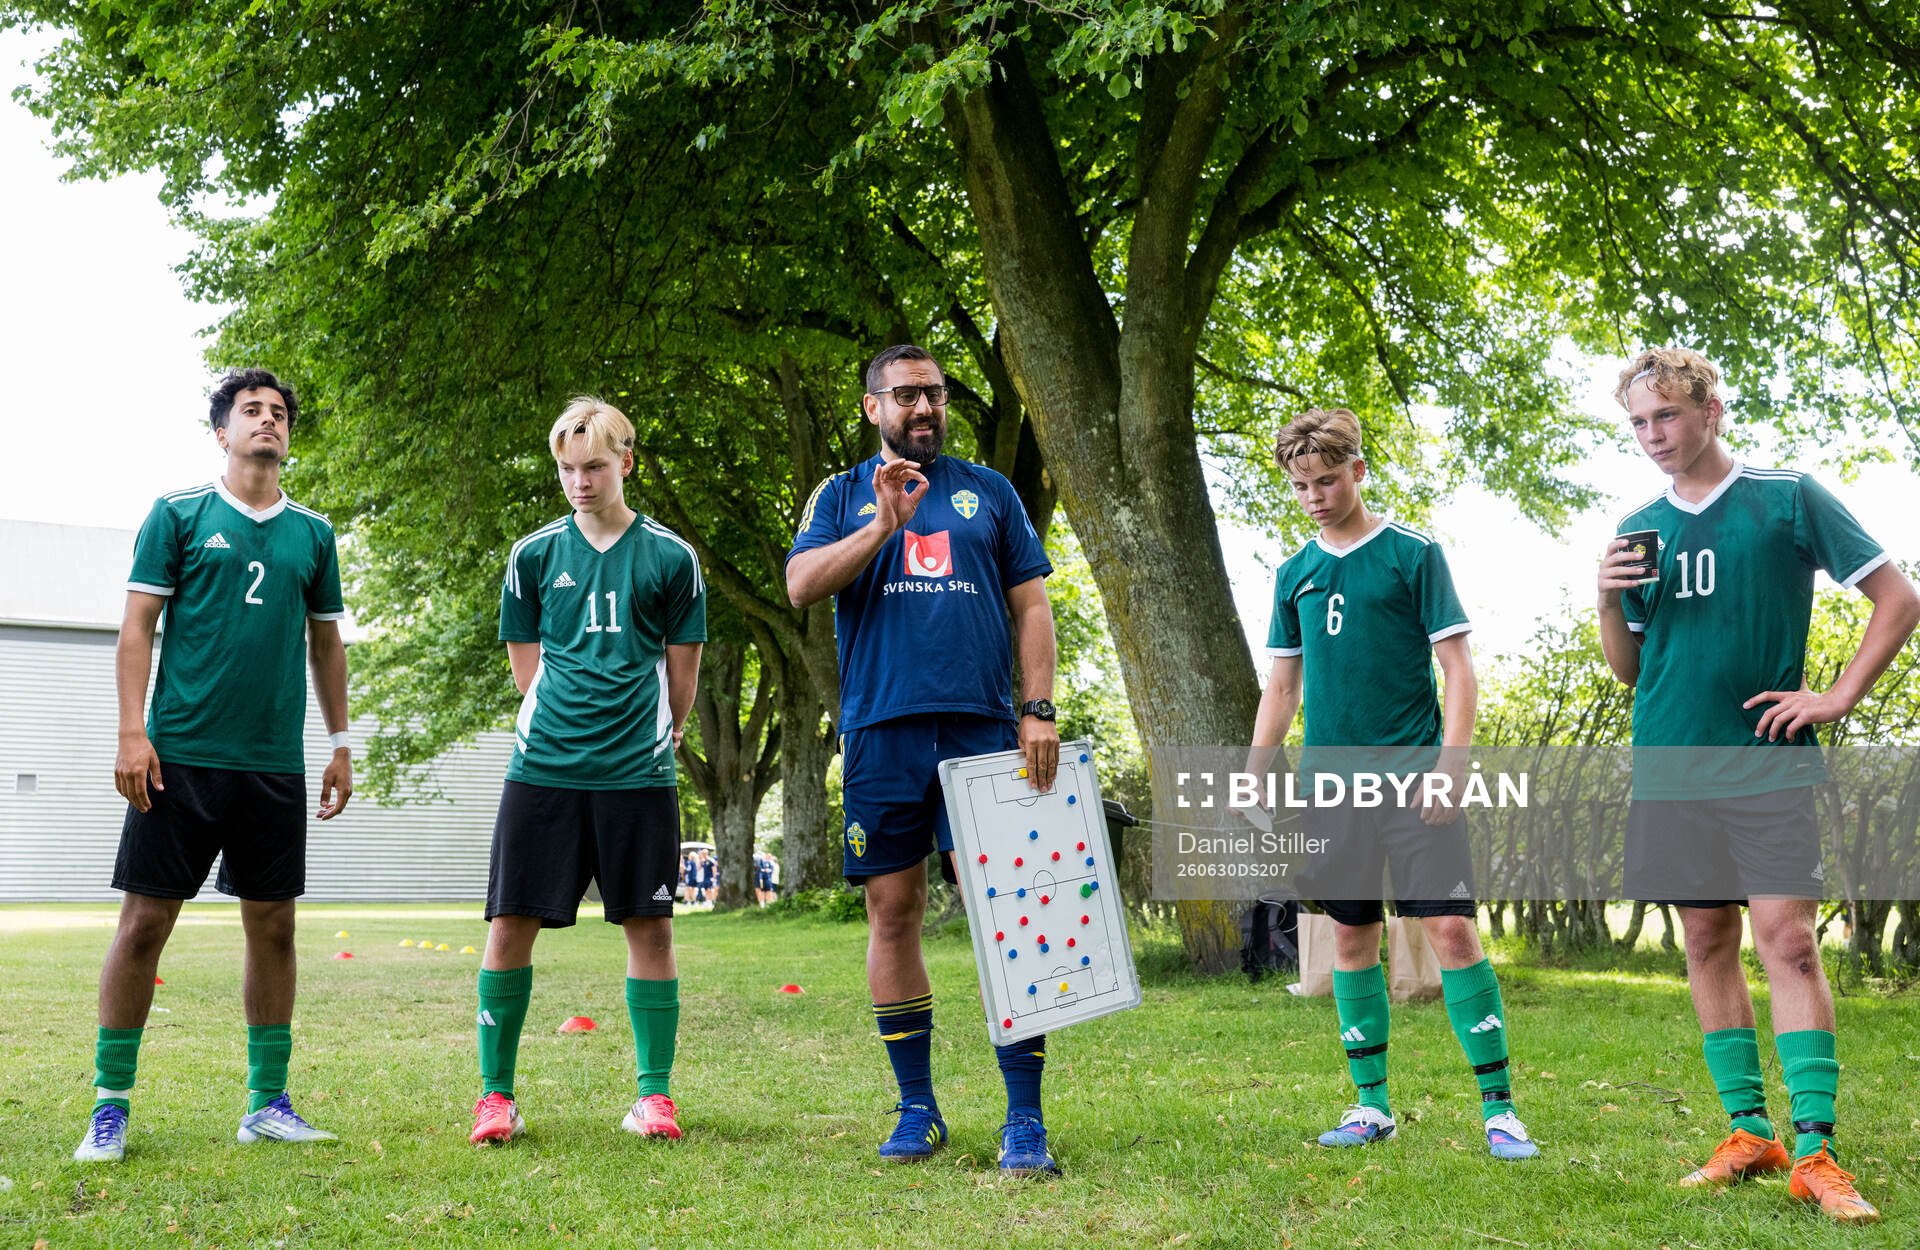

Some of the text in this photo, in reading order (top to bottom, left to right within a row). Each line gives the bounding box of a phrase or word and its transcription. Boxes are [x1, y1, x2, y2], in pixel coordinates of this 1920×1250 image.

[245, 561, 265, 604] 2
[553, 580, 576, 588] adidas
[883, 580, 979, 595] SVENSKA SPEL
[1675, 549, 1716, 599] 10
[585, 591, 622, 633] 11
[1326, 593, 1345, 636] 6
